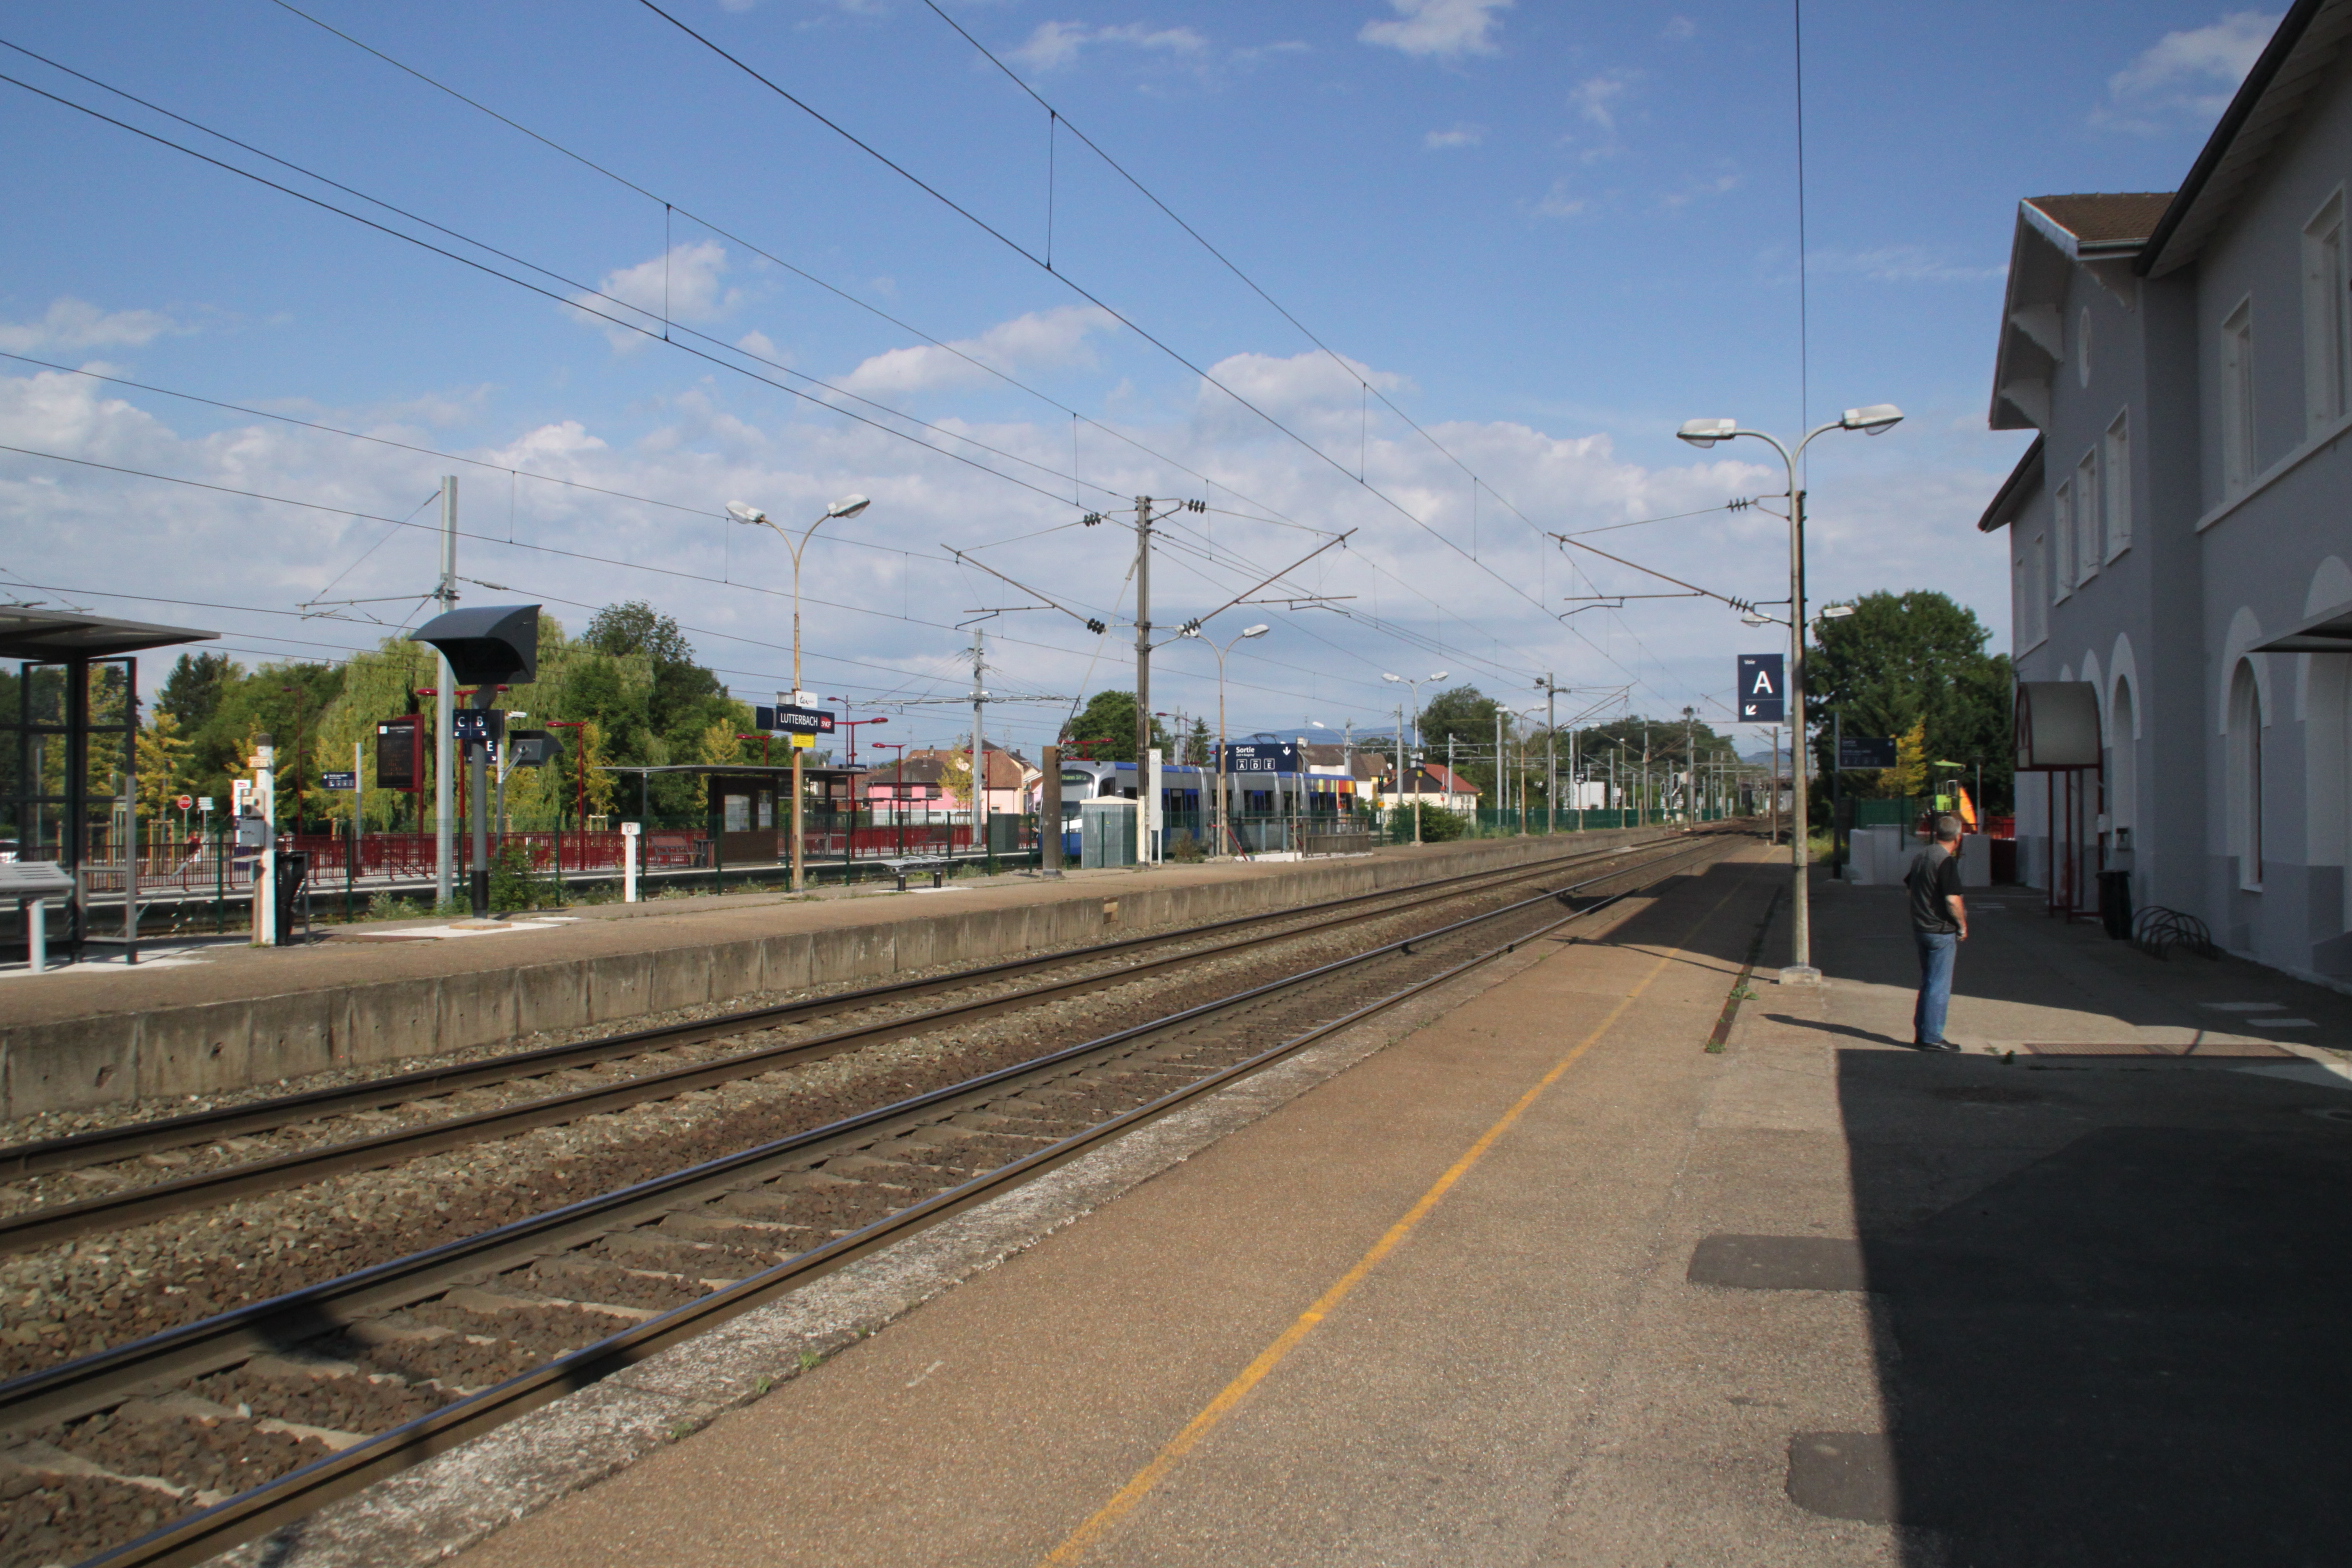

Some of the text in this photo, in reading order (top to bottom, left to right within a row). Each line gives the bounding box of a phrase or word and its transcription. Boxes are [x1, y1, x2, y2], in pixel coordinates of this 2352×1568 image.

[1752, 670, 1773, 694] A
[457, 716, 466, 727] C
[476, 715, 484, 727] B
[780, 712, 818, 726] LUTTERBACH
[486, 740, 494, 752] E
